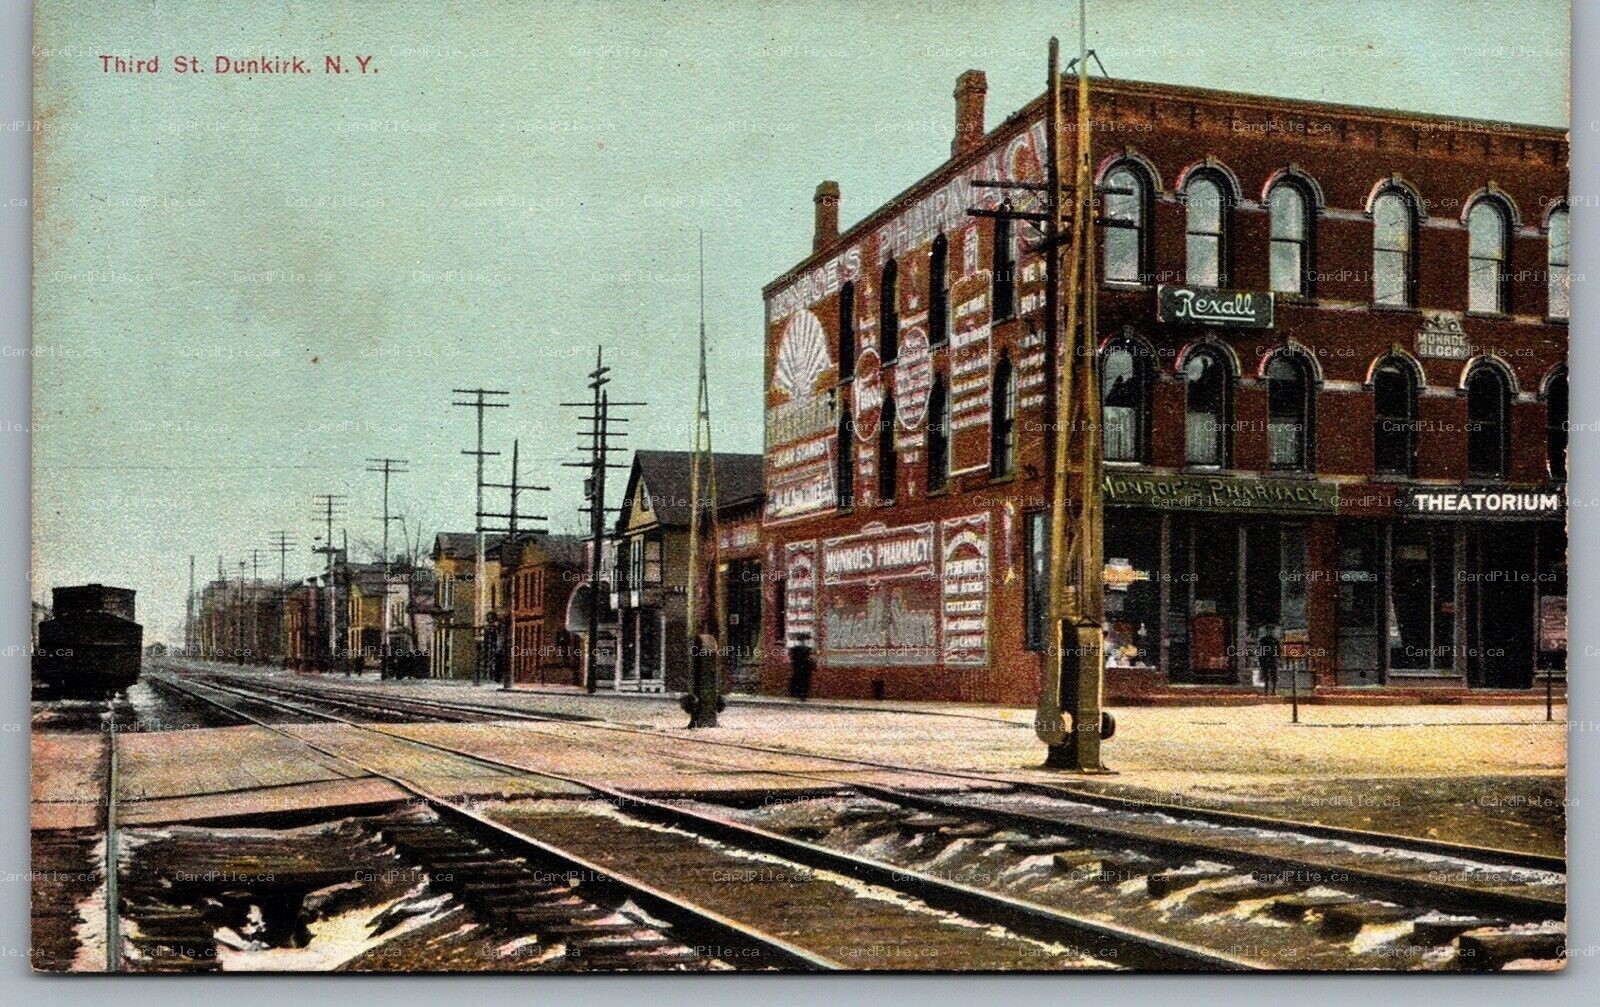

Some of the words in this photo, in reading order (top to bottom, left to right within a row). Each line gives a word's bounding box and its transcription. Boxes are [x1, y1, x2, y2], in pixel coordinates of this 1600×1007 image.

[1173, 289, 1256, 319] Rexall
[1414, 493, 1559, 511] THEATORIUM
[825, 543, 874, 574] MONROE'S
[876, 537, 930, 567] PHARMACY
